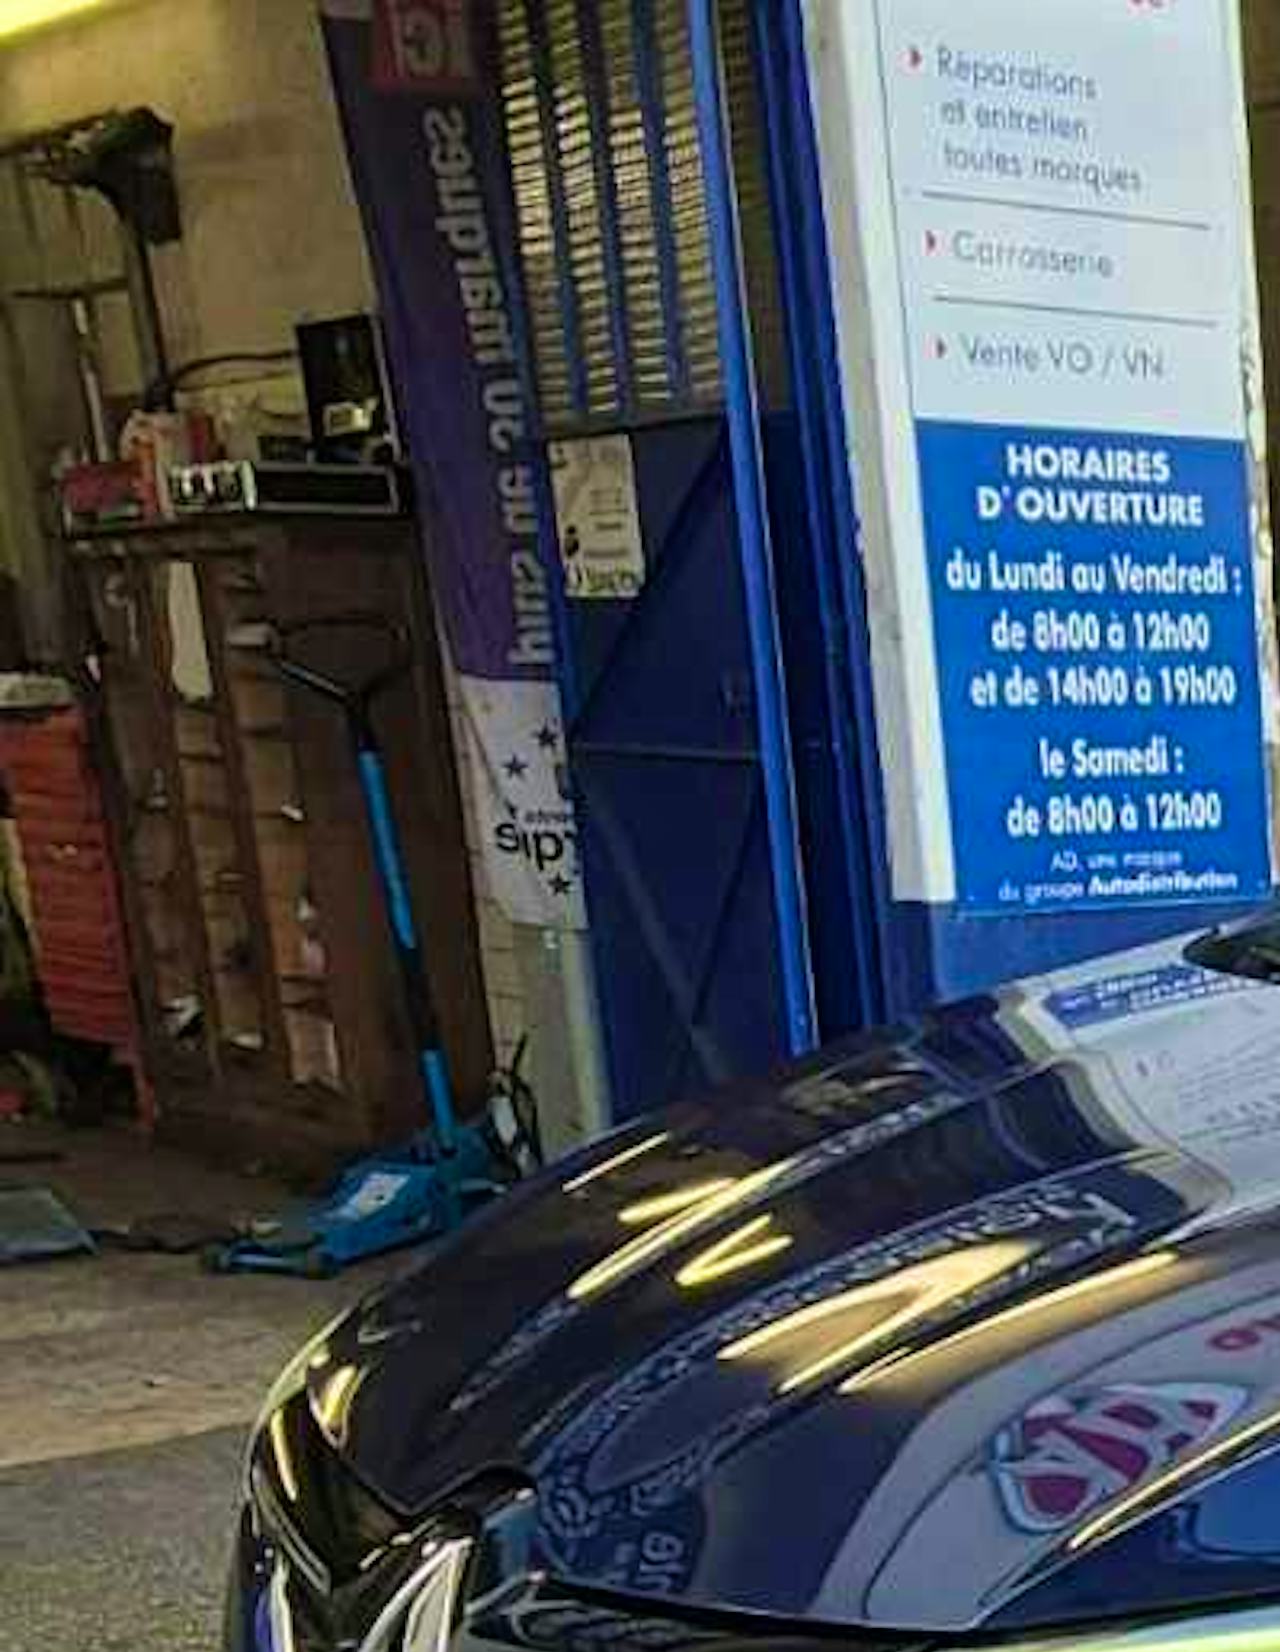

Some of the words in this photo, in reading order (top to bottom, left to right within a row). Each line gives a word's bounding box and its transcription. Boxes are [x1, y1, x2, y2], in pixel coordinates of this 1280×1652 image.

[943, 142, 1022, 178] toutes
[1033, 158, 1141, 196] marques
[952, 229, 1114, 279] Carrosserie
[959, 331, 1040, 373] Vente
[1046, 340, 1094, 375] VO
[1124, 342, 1165, 380] VN
[1007, 444, 1171, 482] HORAIRES
[946, 549, 981, 592] du
[988, 551, 1066, 593] Lundi
[1072, 560, 1105, 594] au
[1113, 554, 1227, 596] Vendredi
[991, 609, 1026, 650] de
[1033, 611, 1100, 652] 8h00
[1106, 613, 1126, 652] à
[1133, 611, 1209, 652] 12h00
[970, 669, 998, 707] et
[1004, 667, 1039, 707] de
[1046, 667, 1129, 706] 14h00
[1159, 668, 1237, 706] 19h00
[1039, 739, 1066, 777] le
[1071, 738, 1170, 779] Samedi
[1007, 794, 1041, 837] de
[1048, 795, 1114, 836] 8h00
[1120, 794, 1139, 834] à
[1146, 791, 1222, 832] 12h00
